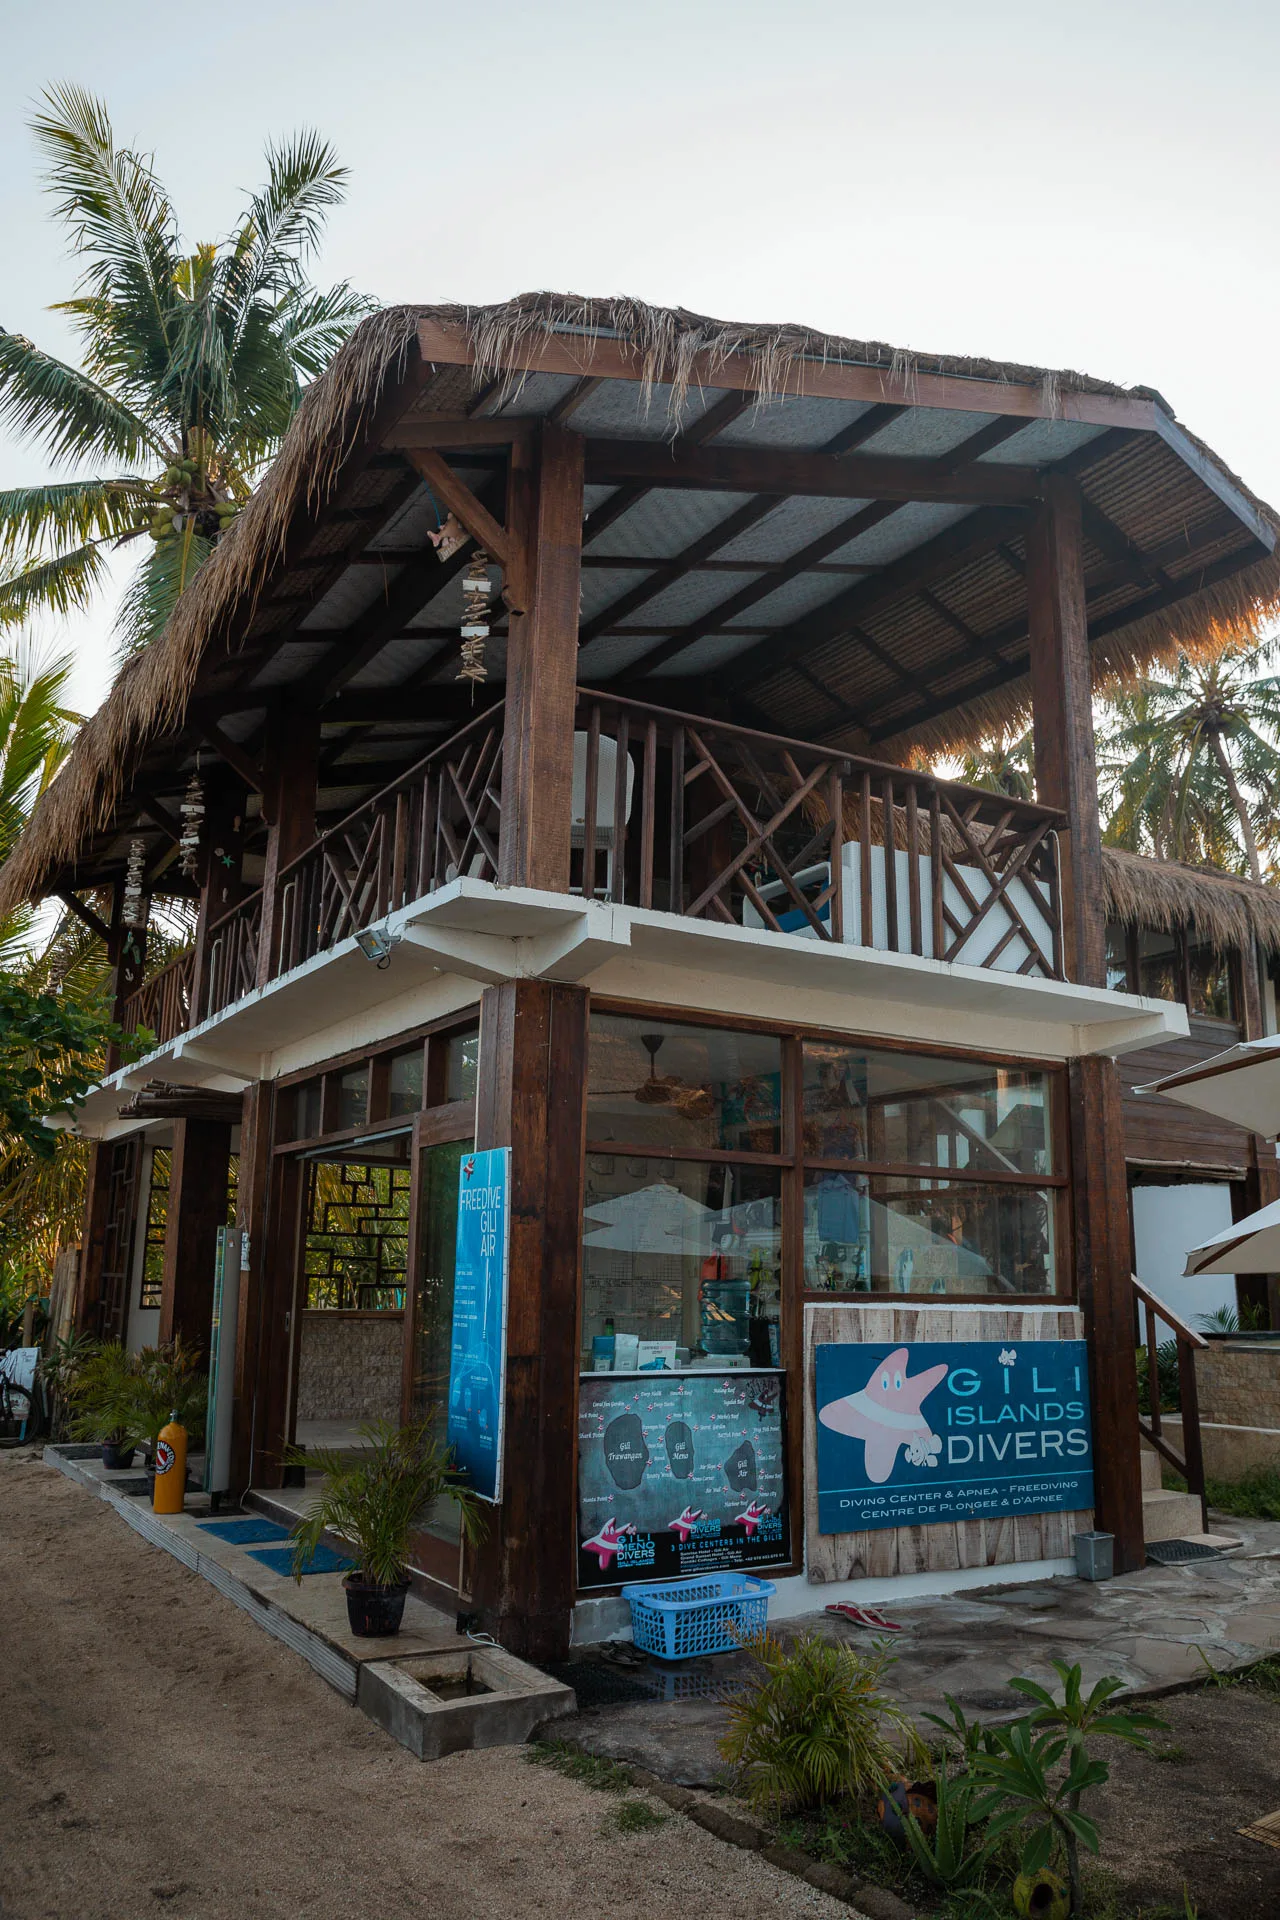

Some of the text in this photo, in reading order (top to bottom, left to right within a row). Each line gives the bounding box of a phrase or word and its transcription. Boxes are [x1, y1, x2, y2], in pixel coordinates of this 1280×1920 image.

[460, 1186, 502, 1211] FREEDIVE
[480, 1210, 497, 1233] GILI
[480, 1234, 496, 1257] AIR
[947, 1366, 1080, 1396] GILI
[947, 1401, 1085, 1426] ISLANDS
[619, 1441, 631, 1452] Gili
[675, 1441, 686, 1452] Gili
[947, 1428, 1089, 1464] DIVERS
[608, 1452, 643, 1462] Trawangan
[672, 1452, 689, 1460] Meno
[737, 1460, 748, 1470] Gili
[738, 1470, 748, 1478] Air
[944, 1490, 954, 1499] &
[1000, 1498, 1010, 1506] &
[690, 1525, 721, 1534] DIVERS
[757, 1523, 782, 1531] DIVERS
[616, 1533, 651, 1544] GILI
[617, 1541, 655, 1552] MENO
[678, 1542, 696, 1551] DIVE
[699, 1538, 734, 1549] CENTERS
[617, 1549, 655, 1561] DIVERS
